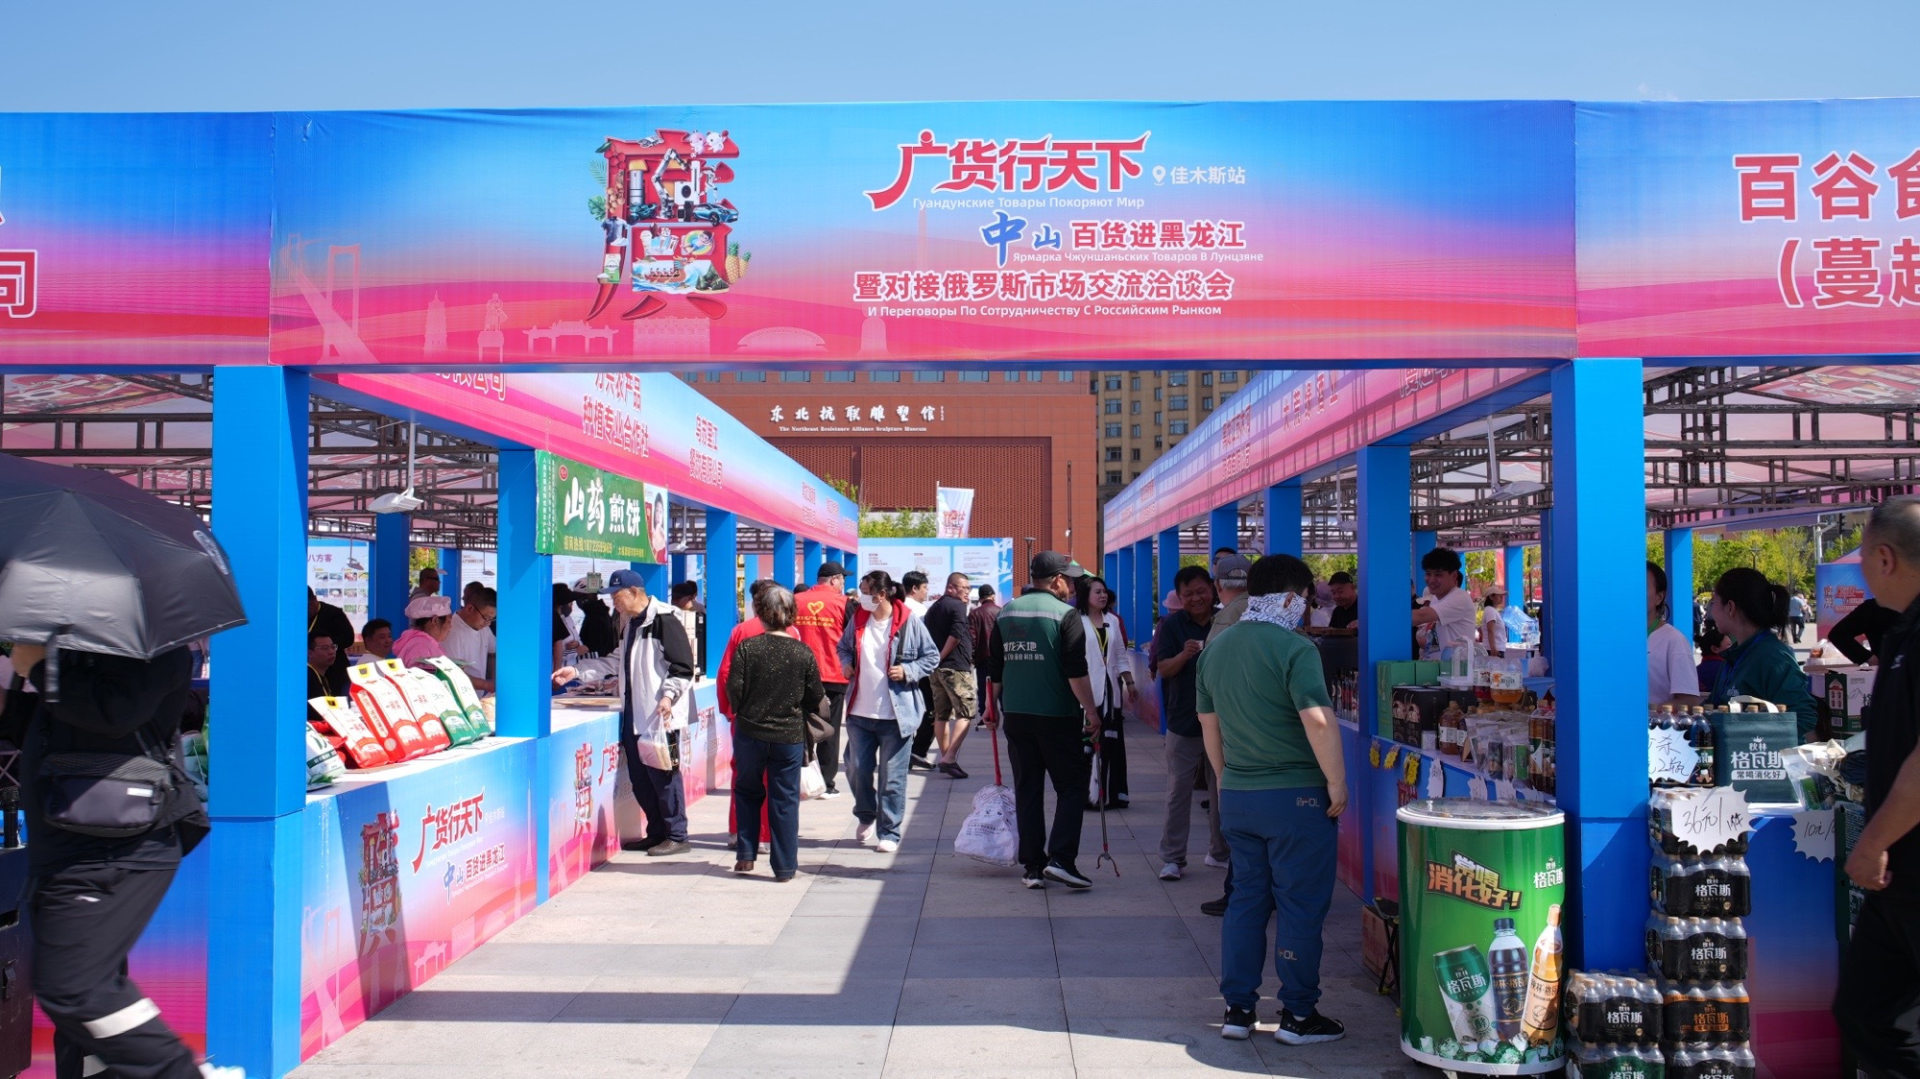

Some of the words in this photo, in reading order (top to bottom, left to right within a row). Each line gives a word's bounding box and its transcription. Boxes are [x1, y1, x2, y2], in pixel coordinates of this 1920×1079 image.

[863, 128, 1152, 211] 广货行天下
[1170, 166, 1246, 185] 佳木斯站
[913, 198, 995, 209] Гуандунские
[998, 198, 1046, 209] Товары
[1050, 197, 1112, 209] Покоряют
[1117, 197, 1144, 209] Мир
[980, 209, 1061, 268] 中山
[1071, 219, 1246, 250] 百货进黑龙江
[1013, 252, 1061, 262] Ярмарка
[1065, 252, 1149, 262] Чжуншаньских
[1152, 252, 1198, 262] Товаров
[1200, 252, 1207, 261] В
[1209, 252, 1264, 263] Лунцзяне
[854, 268, 1235, 302] 暨对接俄罗斯市场交流洽谈会
[868, 307, 877, 316] И
[880, 306, 957, 317] Переговоры
[960, 306, 977, 316] По
[980, 305, 1080, 317] Сотрудничеству
[1083, 305, 1091, 315] С
[1094, 304, 1168, 315] Российским
[1172, 305, 1222, 315] Рынком
[563, 476, 641, 537] 山药煎饼
[411, 786, 485, 876] 广货行天下
[1694, 884, 1731, 897] 格瓦斯
[1690, 947, 1727, 960] 格瓦斯
[1446, 973, 1486, 995] 格瓦斯
[1607, 1011, 1643, 1024] 格瓦斯
